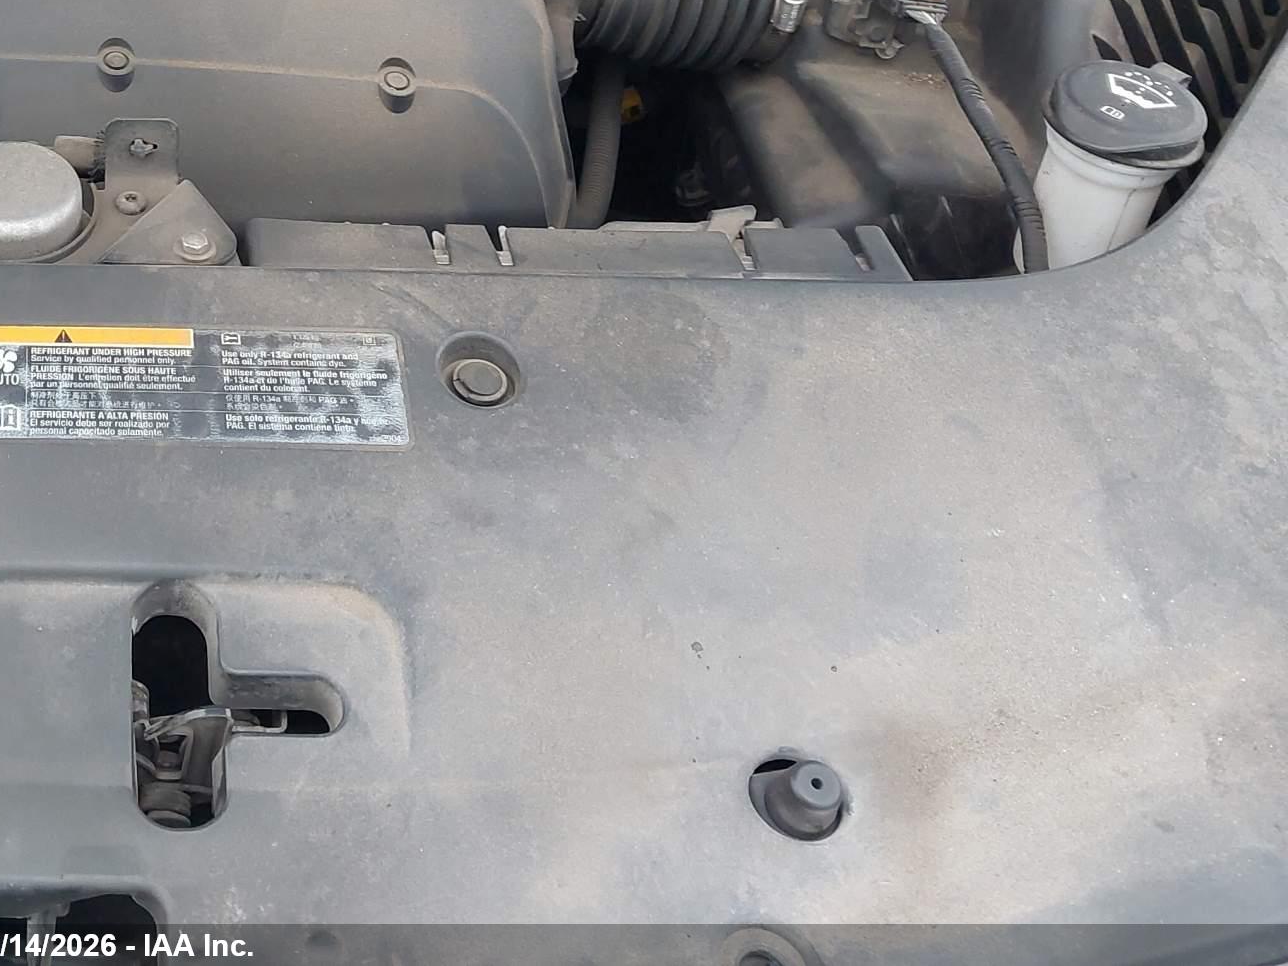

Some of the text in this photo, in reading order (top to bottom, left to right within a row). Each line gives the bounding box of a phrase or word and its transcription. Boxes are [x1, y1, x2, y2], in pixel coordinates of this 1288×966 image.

[30, 347, 192, 357] REFRIGERANT UNDER HIGH PRESSURE
[221, 350, 238, 359] Use
[240, 351, 257, 360] only
[260, 352, 292, 360] R-134a
[294, 352, 340, 362] refrigerant
[30, 354, 176, 365] Service by qualified personnel only.
[221, 357, 346, 368] PAG oil. System contains dye.
[30, 365, 61, 373] FLUIDE
[122, 366, 146, 374] SOUS
[147, 367, 177, 375] HAUTE
[223, 368, 253, 376] Utiliser
[255, 369, 300, 377] seulement
[302, 370, 311, 378] le
[312, 370, 338, 378] fluide
[124, 374, 140, 382] doit
[142, 374, 160, 382] être
[161, 375, 196, 383] effectué
[223, 376, 253, 384] R-134a
[328, 378, 339, 386] Le
[30, 381, 45, 390] par
[46, 381, 58, 389] un
[59, 381, 101, 390] personnel
[223, 384, 259, 392] contient
[260, 384, 271, 392] du
[30, 410, 96, 419] REFRIGERANTE
[225, 414, 243, 422] Use
[265, 415, 319, 425] refrigerante
[29, 418, 170, 430] El servicio debe ser realizado por
[226, 422, 246, 430] PAG.
[248, 422, 256, 430] El
[258, 423, 293, 431] sistema
[295, 423, 332, 432] contiene
[29, 428, 67, 437] personal
[68, 428, 115, 437] capacitado
